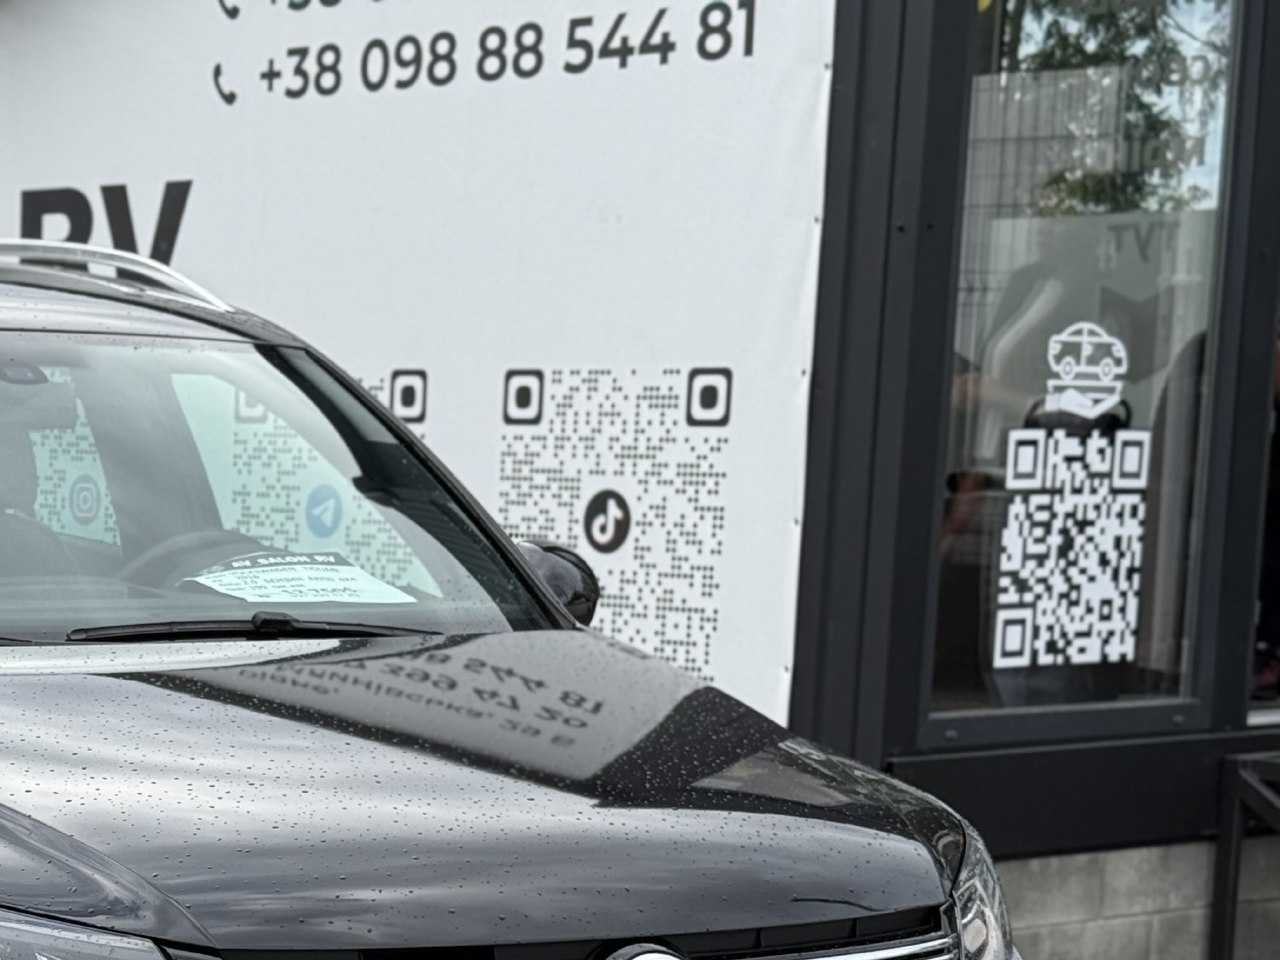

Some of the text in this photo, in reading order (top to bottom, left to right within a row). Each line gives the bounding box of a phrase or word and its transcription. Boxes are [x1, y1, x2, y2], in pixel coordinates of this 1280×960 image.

[259, 0, 756, 99] +38 098 88 544 81
